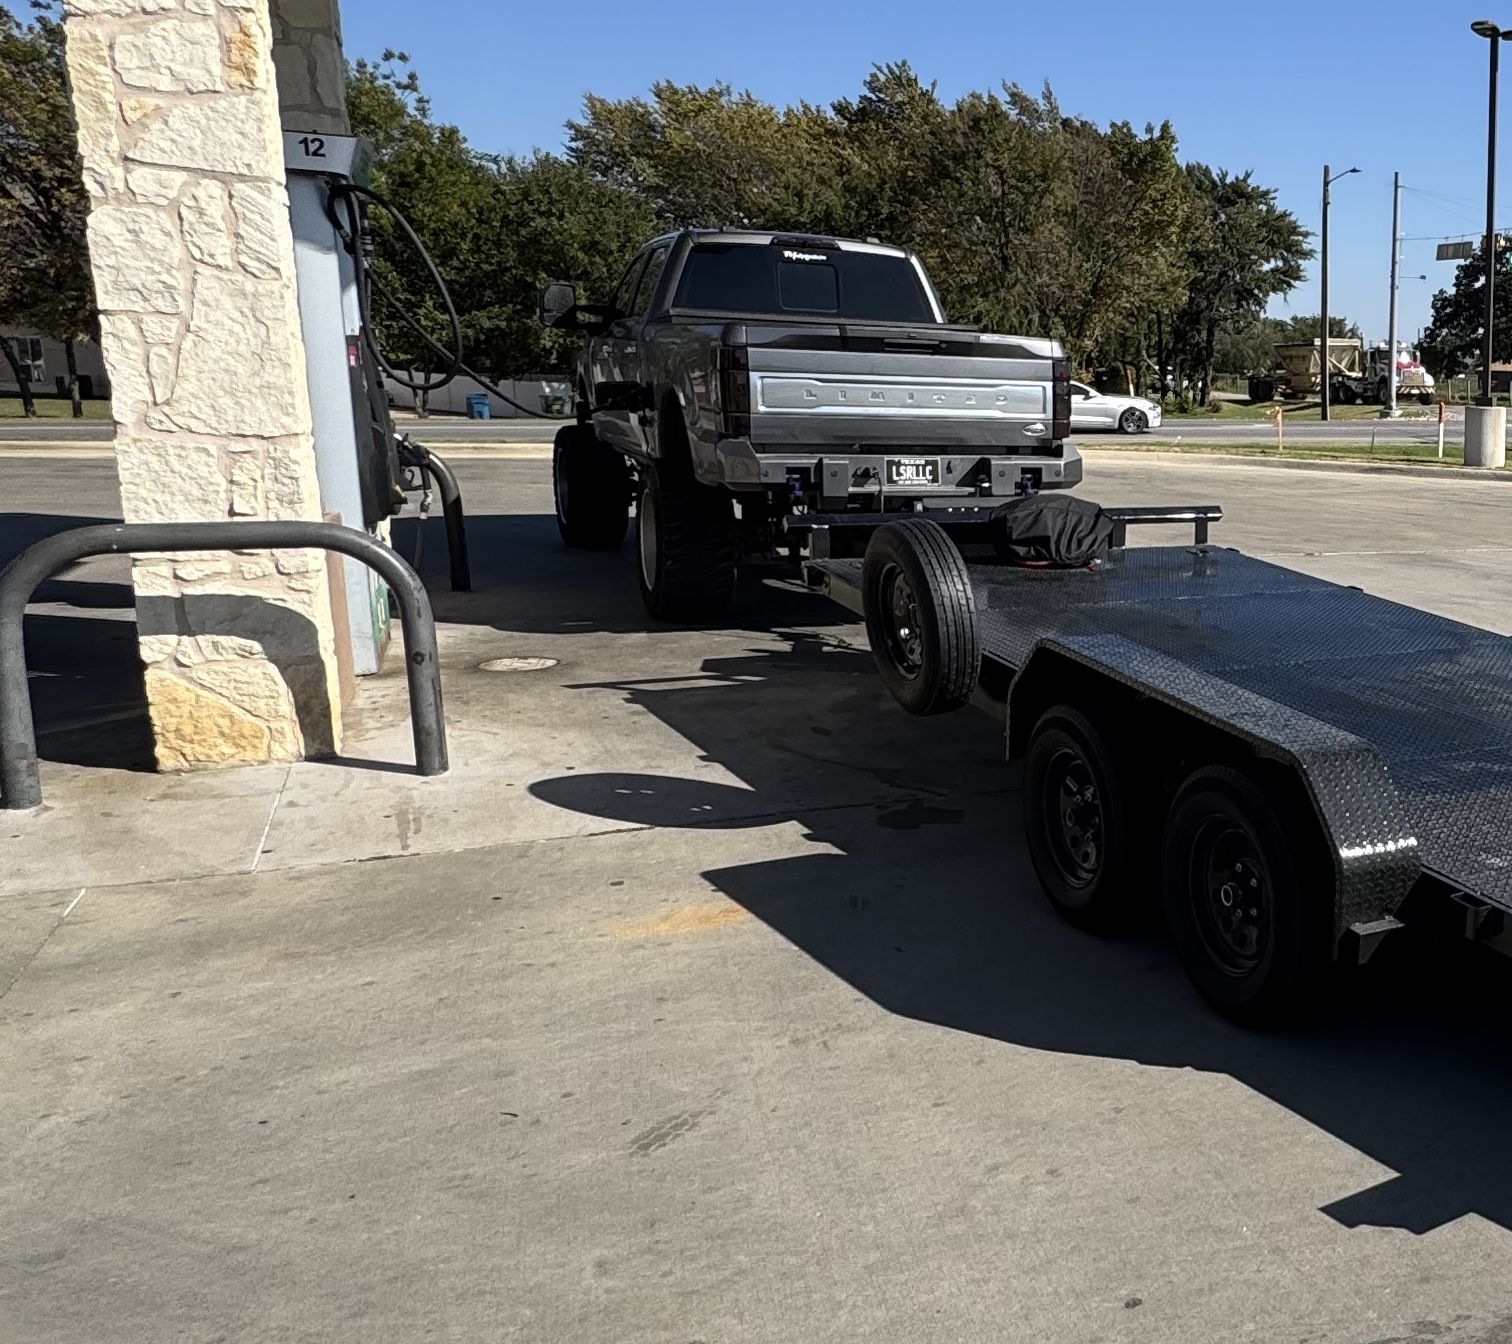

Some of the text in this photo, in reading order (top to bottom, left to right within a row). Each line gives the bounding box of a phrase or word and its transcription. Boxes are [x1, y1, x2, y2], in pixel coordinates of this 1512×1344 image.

[298, 137, 326, 158] 12
[804, 390, 1008, 405] LIMITED
[892, 465, 933, 480] LSRLLC
